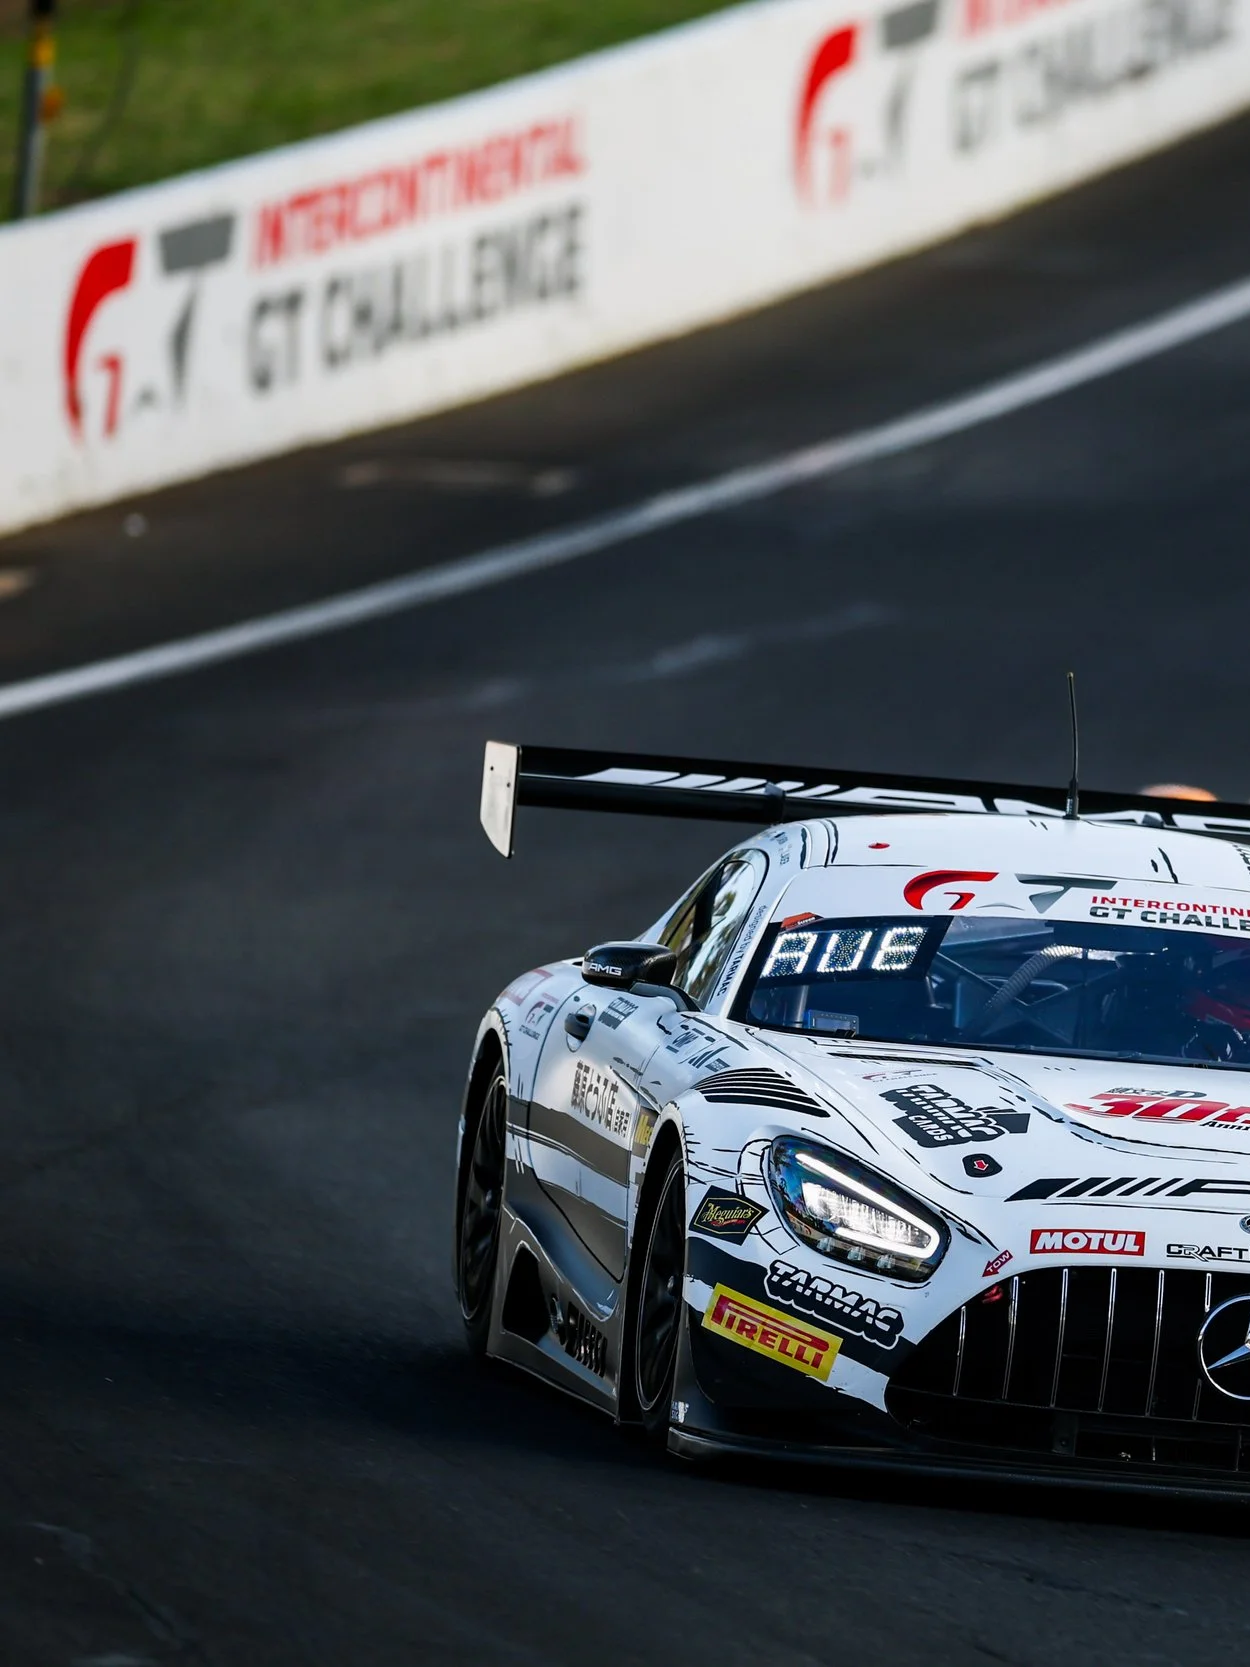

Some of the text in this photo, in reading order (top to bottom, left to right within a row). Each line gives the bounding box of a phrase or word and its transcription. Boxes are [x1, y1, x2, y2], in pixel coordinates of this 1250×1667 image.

[254, 114, 589, 272] INTERCONTINENTAL
[246, 197, 587, 394] GT CHALLENGE
[1089, 906, 1132, 920] GT
[588, 962, 622, 976] AMG
[761, 926, 927, 978] AUE
[717, 954, 744, 997] TARMAC
[908, 1114, 954, 1144] CARDS
[701, 1202, 755, 1224] Meguiar's
[1035, 1231, 1141, 1254] MOTUL
[986, 1250, 1010, 1274] TOW
[771, 1261, 899, 1332] TARMAC
[711, 1294, 830, 1370] PIRELLI
